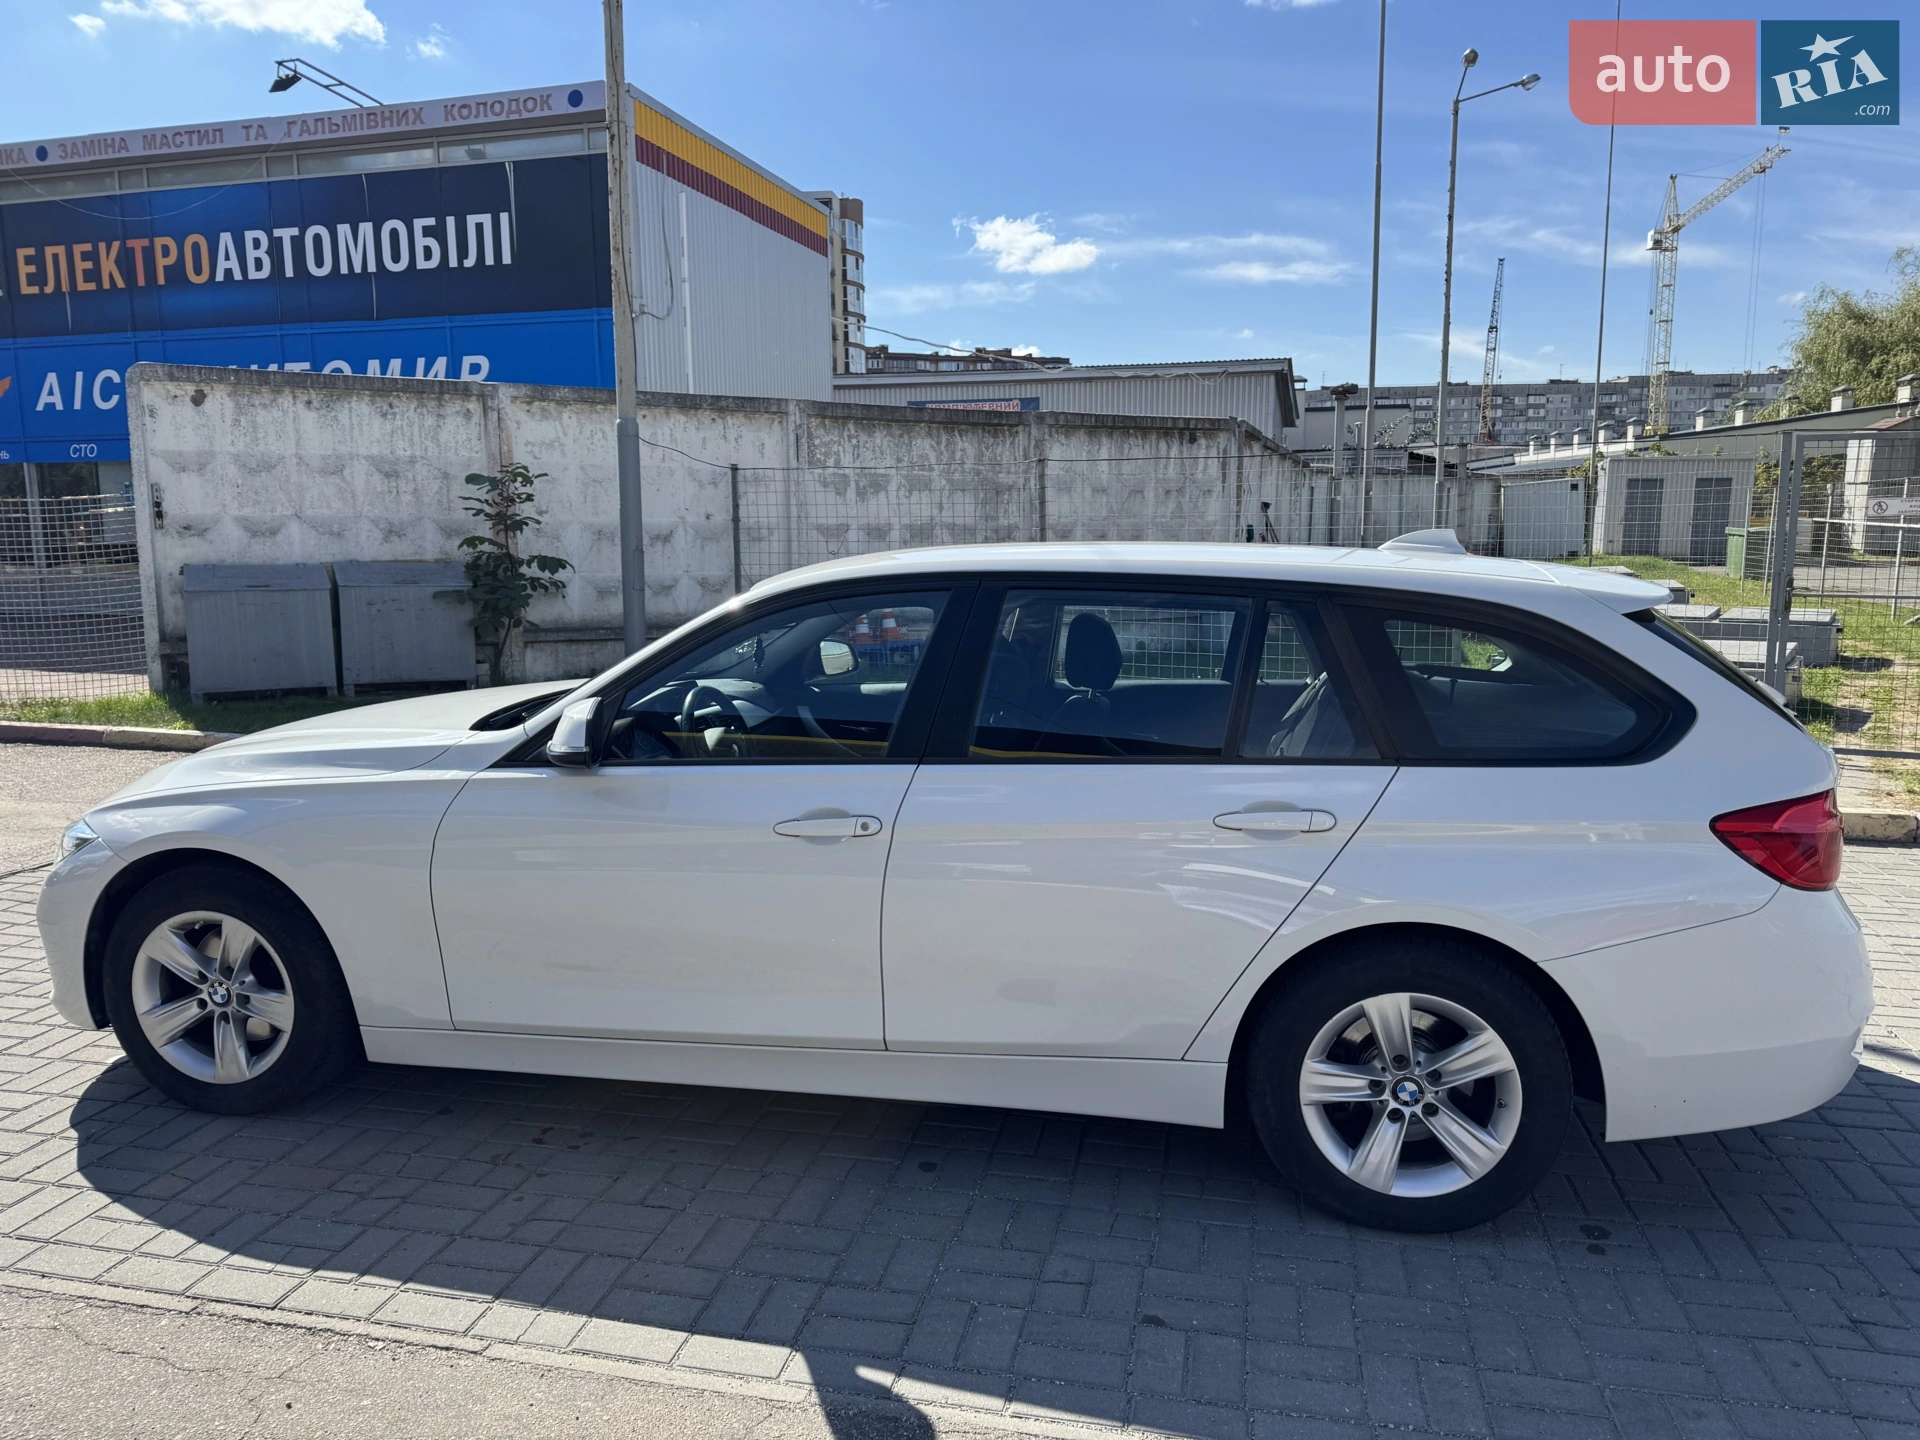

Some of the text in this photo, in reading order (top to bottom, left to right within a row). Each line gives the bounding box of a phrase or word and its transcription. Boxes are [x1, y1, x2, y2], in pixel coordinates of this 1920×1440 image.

[0, 147, 29, 166] КА
[57, 136, 130, 161] ЗАМІНА
[142, 126, 224, 151] МАСТИЛ
[241, 124, 268, 142] ТА
[443, 92, 553, 122] КОЛОДОК
[15, 211, 513, 295] ЕЛЕКТРОАВТОМОБІЛІ
[69, 443, 98, 458] СТО
